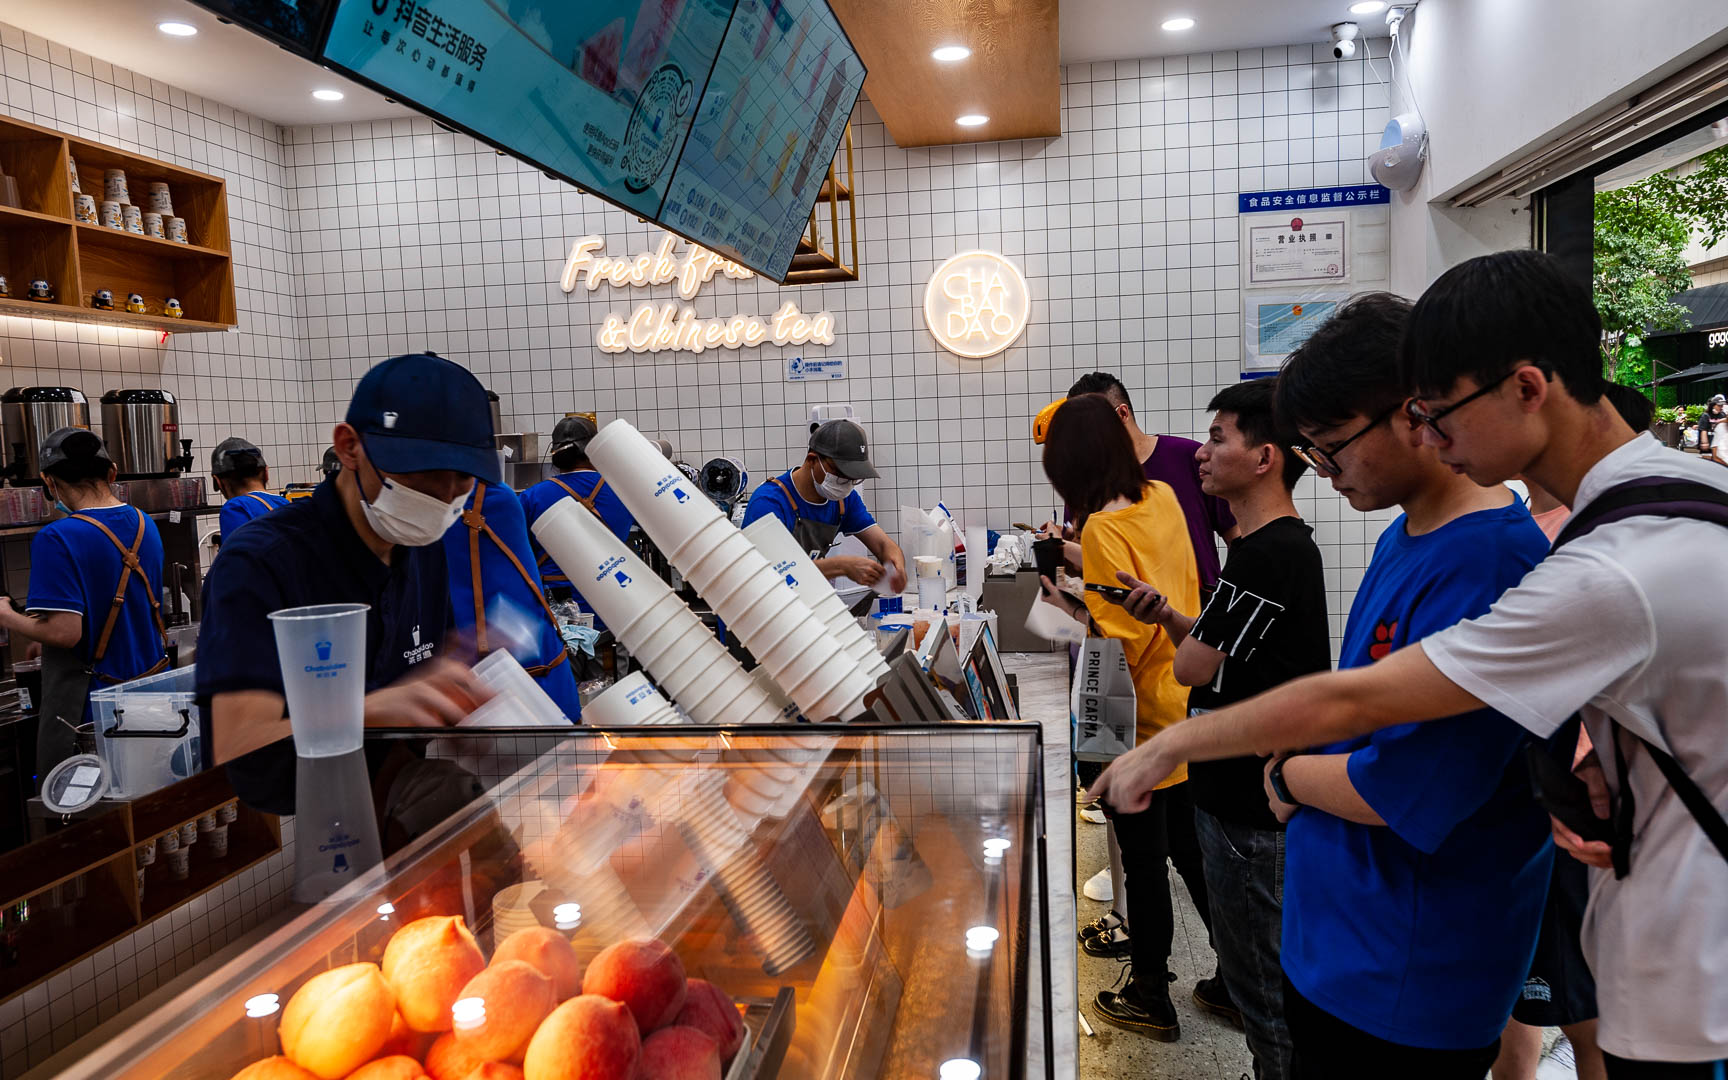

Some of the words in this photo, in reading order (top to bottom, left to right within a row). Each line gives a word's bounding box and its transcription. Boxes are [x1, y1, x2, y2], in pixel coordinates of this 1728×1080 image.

[393, 0, 488, 72] 抖音生活服务
[1248, 189, 1381, 208] 食品安全信息监督公示栏
[562, 236, 677, 288] Fresh
[681, 245, 755, 296] fru
[774, 301, 831, 342] tea
[1086, 651, 1100, 694] PRINCE
[1084, 698, 1099, 739] CARMA
